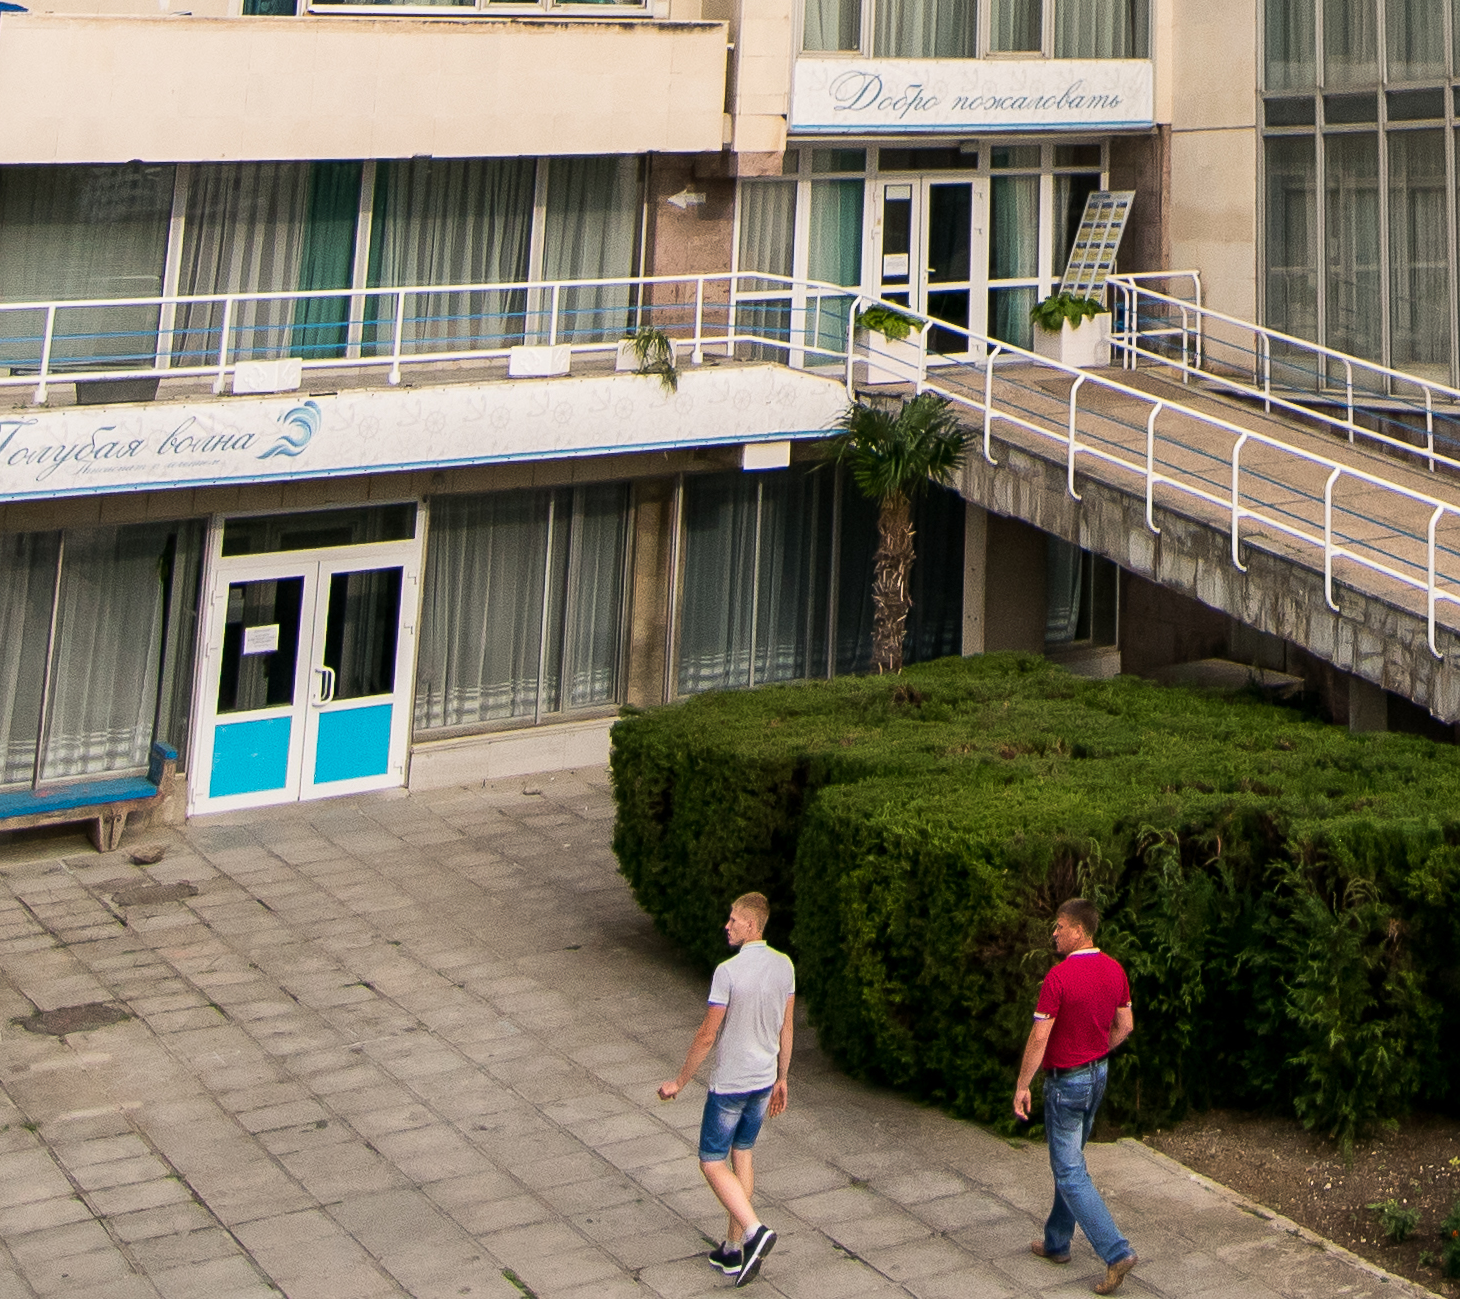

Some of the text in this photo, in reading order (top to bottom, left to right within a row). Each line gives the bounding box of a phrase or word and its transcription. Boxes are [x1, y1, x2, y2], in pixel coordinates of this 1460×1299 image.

[829, 70, 1122, 119] Добро пожаловать
[157, 416, 256, 455] волна
